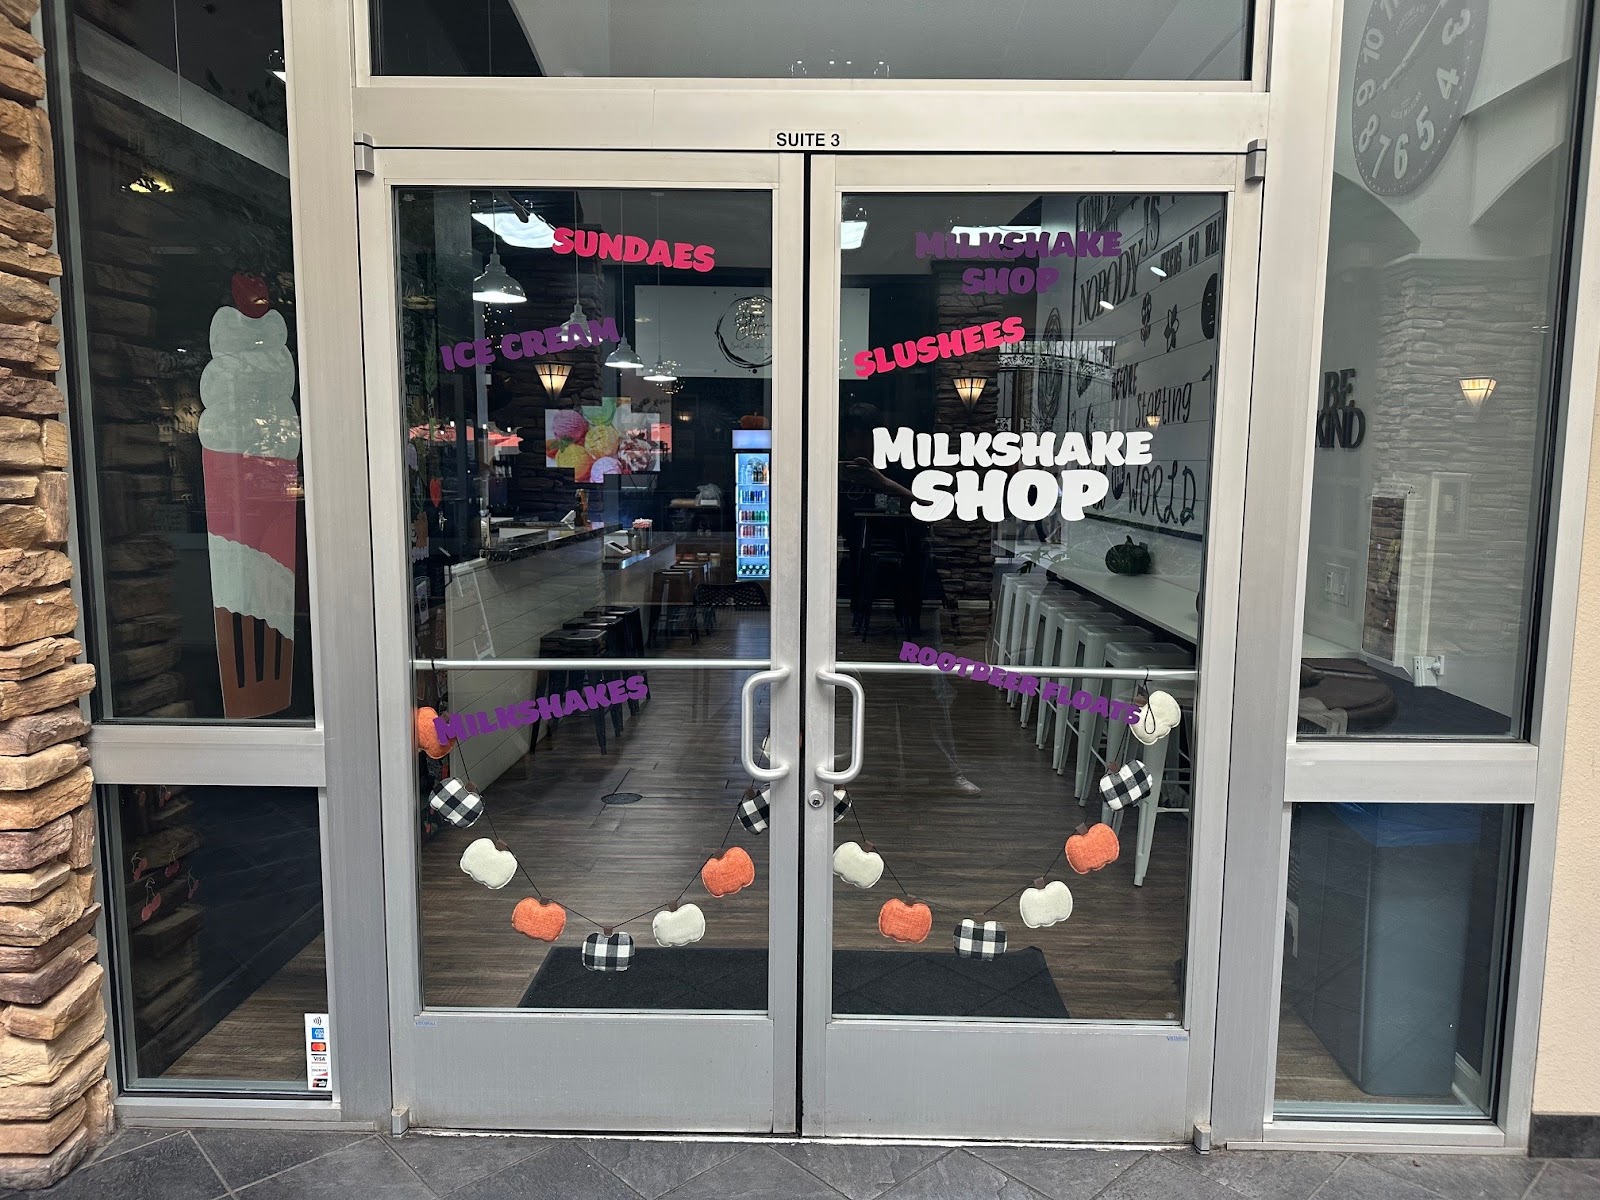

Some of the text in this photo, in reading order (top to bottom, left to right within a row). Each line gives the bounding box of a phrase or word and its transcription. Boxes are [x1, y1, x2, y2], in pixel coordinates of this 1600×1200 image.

[1363, 28, 1384, 64] 10
[1442, 9, 1471, 46] 3
[1357, 78, 1376, 107] 9
[1436, 67, 1460, 100] 4
[776, 132, 841, 147] SUITE 3
[1359, 114, 1379, 153] 8
[1416, 105, 1435, 151] 5
[1372, 135, 1392, 179] 7
[1394, 133, 1409, 180] 6
[552, 227, 715, 272] SUNDAES
[915, 231, 1122, 260] MILKSHAKE
[1188, 231, 1200, 267] TO
[962, 266, 1060, 296] SHOP
[1078, 238, 1145, 326] NOBODY
[440, 338, 497, 371] ICE
[500, 316, 621, 361] CREAM
[853, 316, 1025, 378] SLUSHEES
[1324, 368, 1356, 408] BE
[872, 426, 1154, 470] MILKSHAKE
[909, 469, 1110, 522] SHOP
[1126, 460, 1197, 527] WORLD
[899, 641, 1141, 725] ROOTBEER FLOATS
[432, 674, 650, 746] MILKSHAKES
